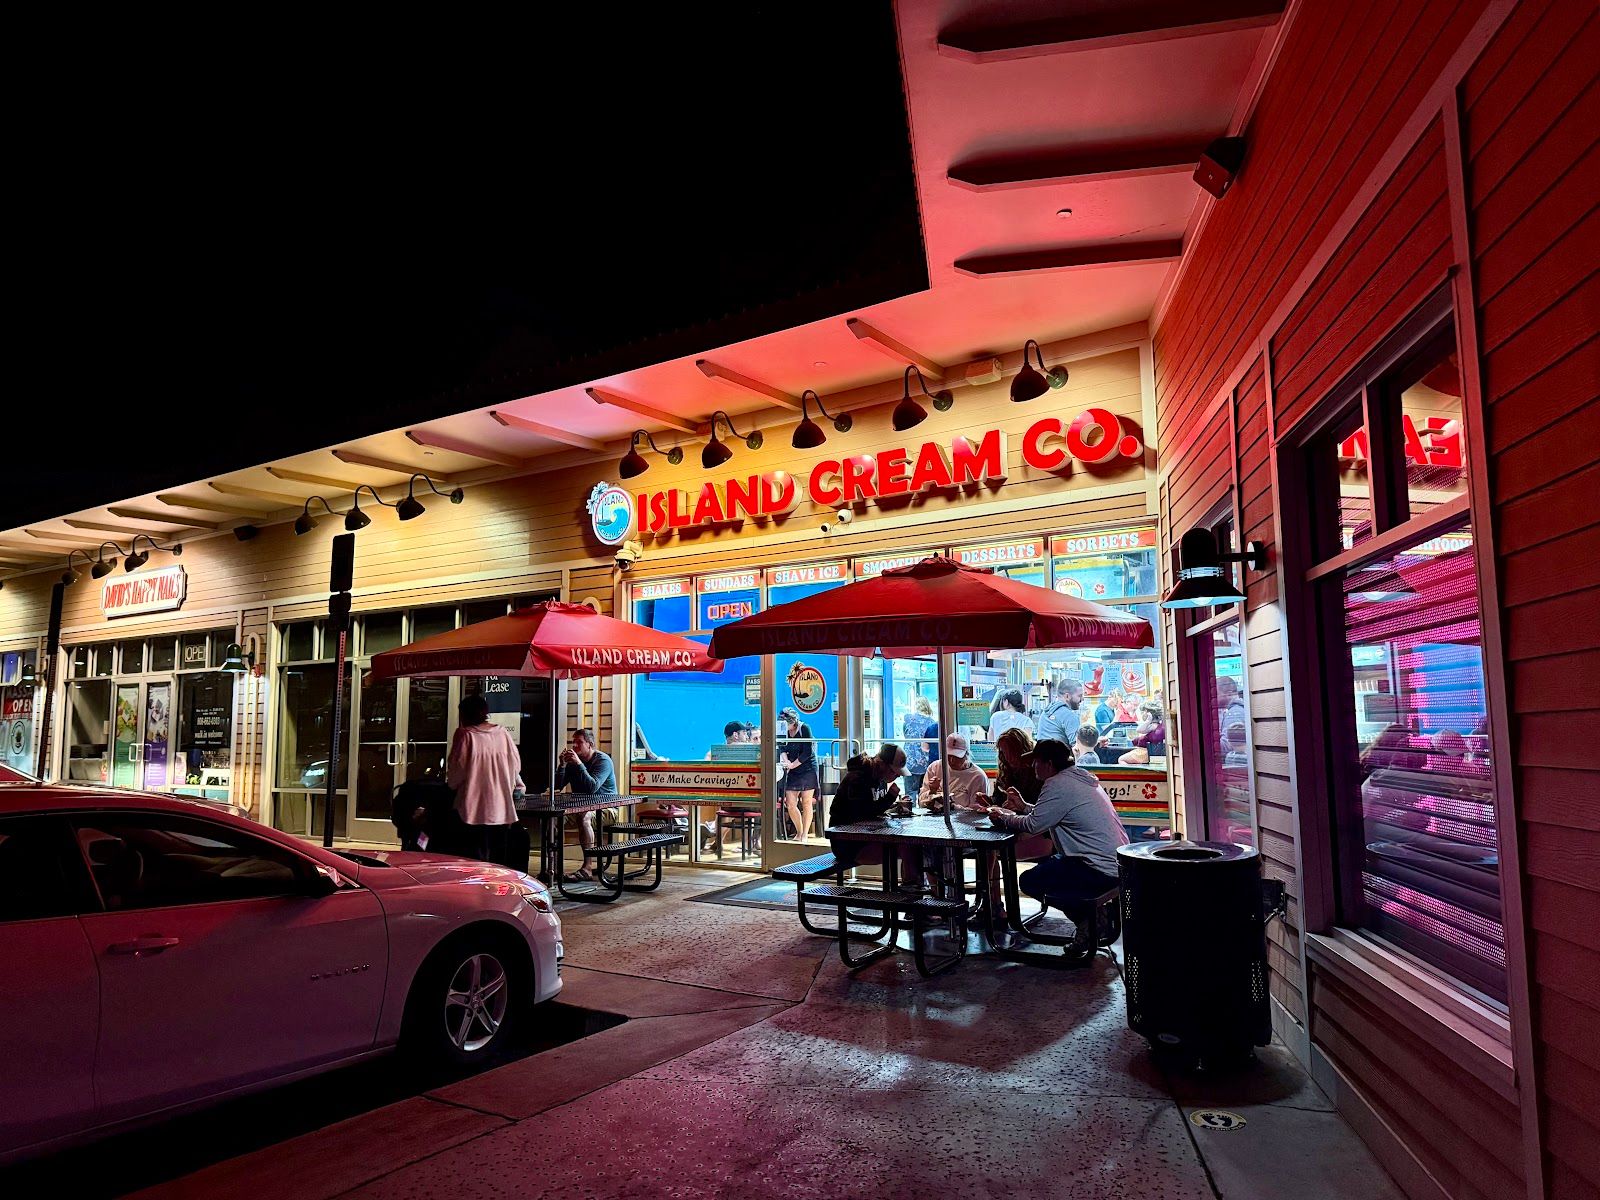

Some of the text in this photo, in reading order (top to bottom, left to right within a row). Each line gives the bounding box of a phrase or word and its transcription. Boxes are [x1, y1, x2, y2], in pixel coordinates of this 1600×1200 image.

[637, 408, 1141, 533] ISLAND CREAM CO.
[1066, 532, 1139, 551] SORBETS
[961, 544, 1036, 564] DESSERTS
[704, 575, 755, 591] SUNDAES
[775, 565, 840, 583] SHAVE ICE
[642, 583, 682, 598] SHAKES
[707, 601, 752, 620] OPEN
[760, 627, 829, 649] ISLAND
[836, 622, 911, 643] CREAM
[571, 648, 623, 665] ISLAND
[626, 648, 671, 665] CREAM
[485, 681, 510, 693] Lease
[651, 774, 665, 783] We
[667, 774, 691, 784] Make
